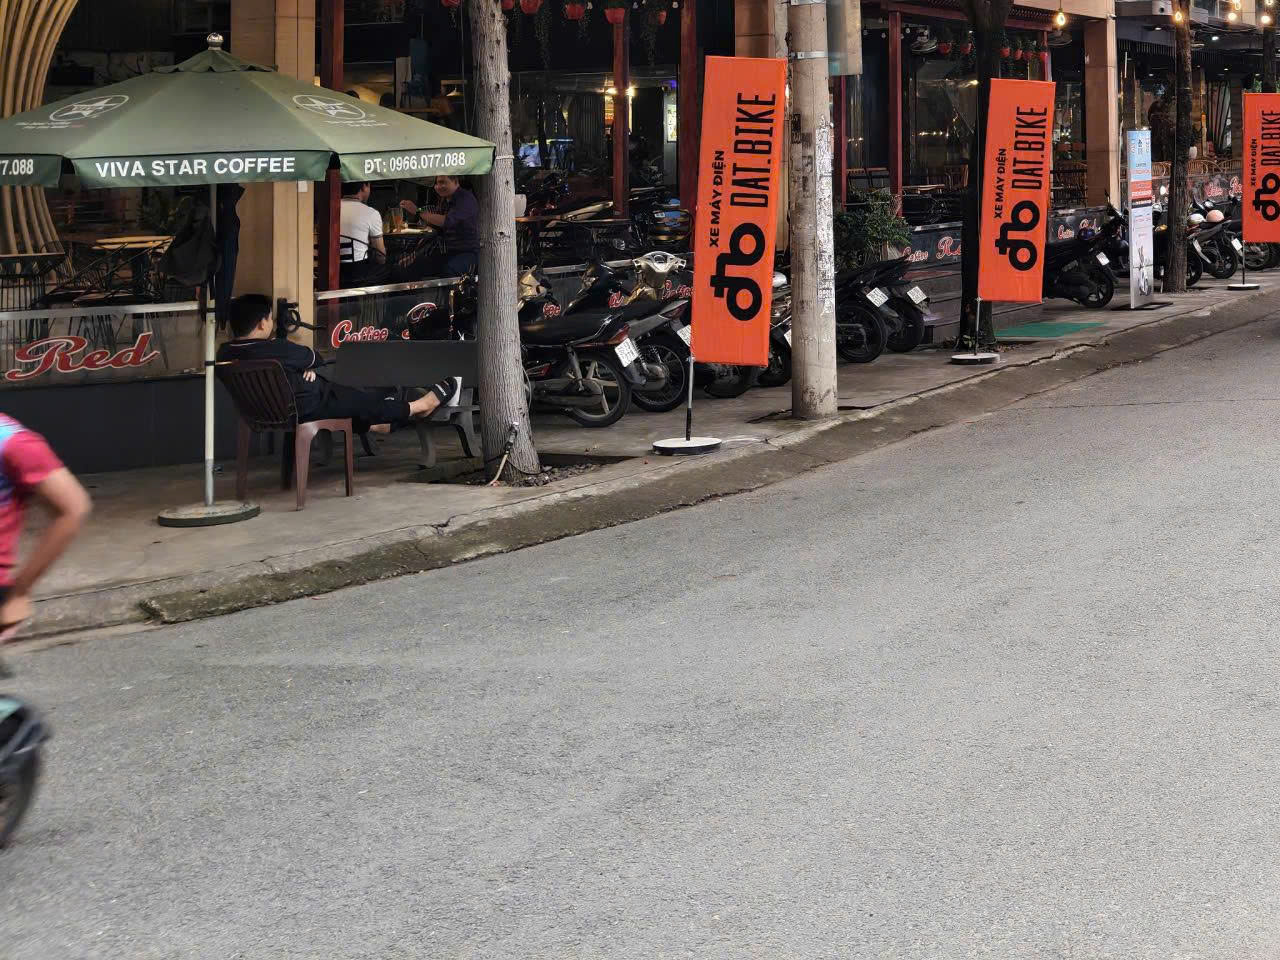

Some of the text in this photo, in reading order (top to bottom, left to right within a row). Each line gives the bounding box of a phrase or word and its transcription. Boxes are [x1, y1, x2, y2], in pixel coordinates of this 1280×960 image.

[95, 156, 296, 178] VIVA STAR COFFEE
[364, 151, 467, 174] ĐT: 0966.077.088
[729, 92, 776, 208] DAT.BIKE
[1011, 105, 1048, 191] DAT.BIKE
[709, 150, 726, 248] XE MÁY ĐIỆN
[994, 204, 1003, 219] XE
[4, 331, 161, 381] Red
